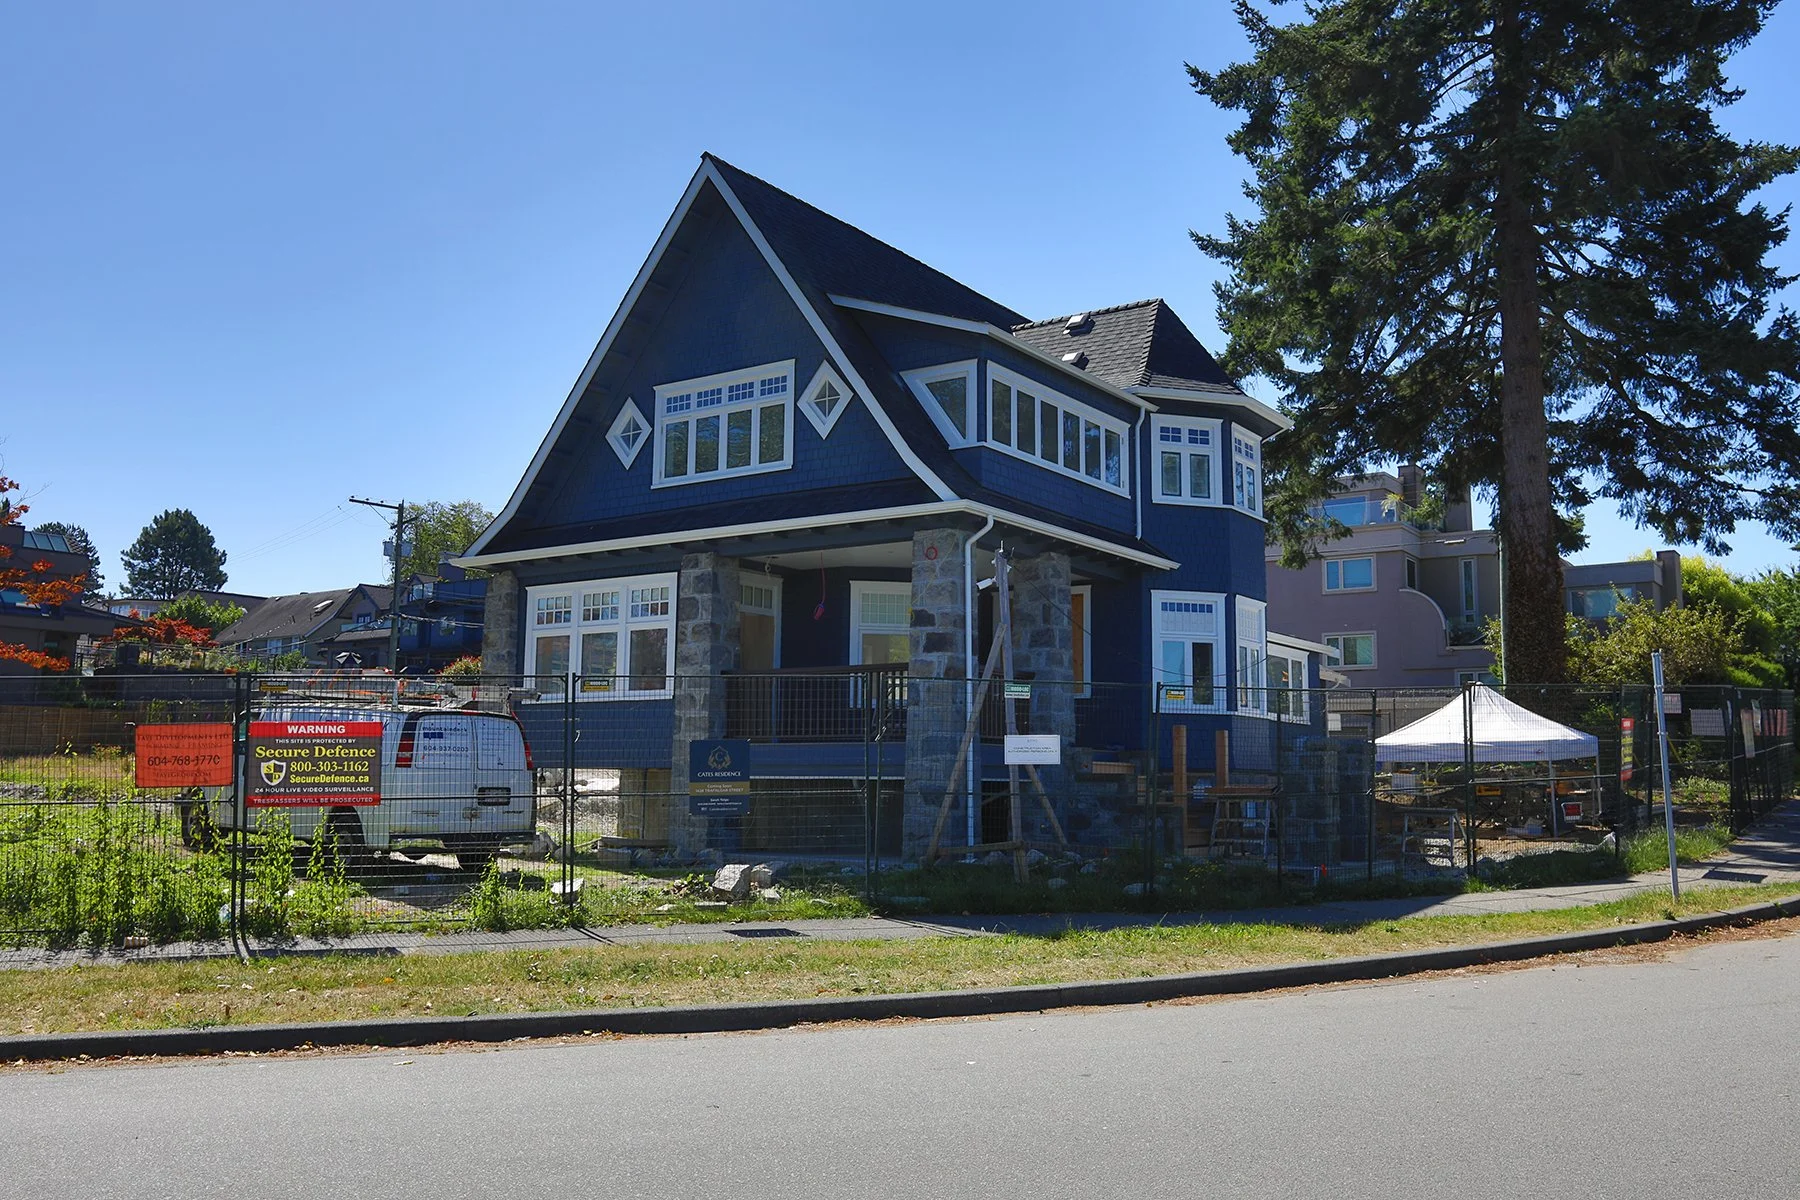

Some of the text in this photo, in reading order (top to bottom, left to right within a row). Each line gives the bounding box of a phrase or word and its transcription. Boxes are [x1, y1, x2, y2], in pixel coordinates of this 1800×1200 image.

[287, 725, 346, 734] WARNING
[255, 745, 376, 758] Secure Defence
[147, 755, 221, 766] 604-768-1770
[289, 761, 370, 772] 800-303-1162
[289, 774, 370, 783] SecureDefence.ca
